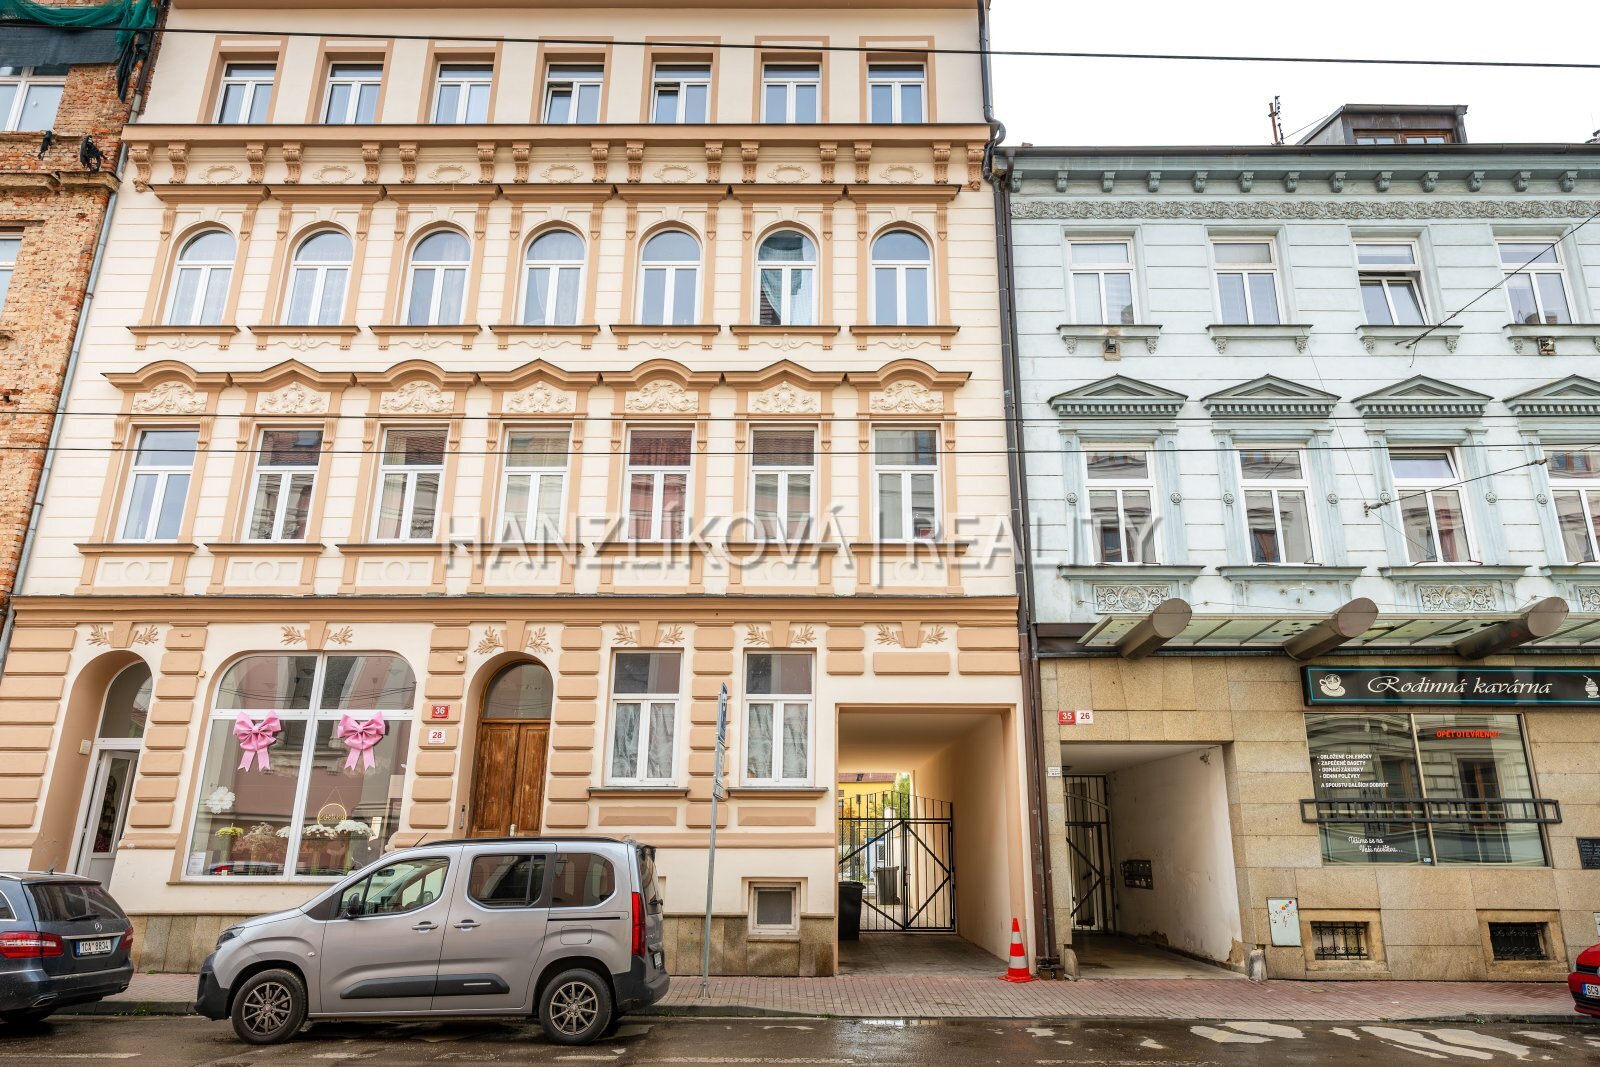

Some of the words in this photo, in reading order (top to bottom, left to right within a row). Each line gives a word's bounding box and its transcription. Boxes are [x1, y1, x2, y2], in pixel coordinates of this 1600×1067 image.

[1367, 675, 1467, 694] Rodinná
[1473, 677, 1553, 695] kavárna
[435, 706, 446, 715] 36
[1062, 712, 1073, 720] 35
[1080, 712, 1091, 720] 26
[432, 731, 443, 739] 28
